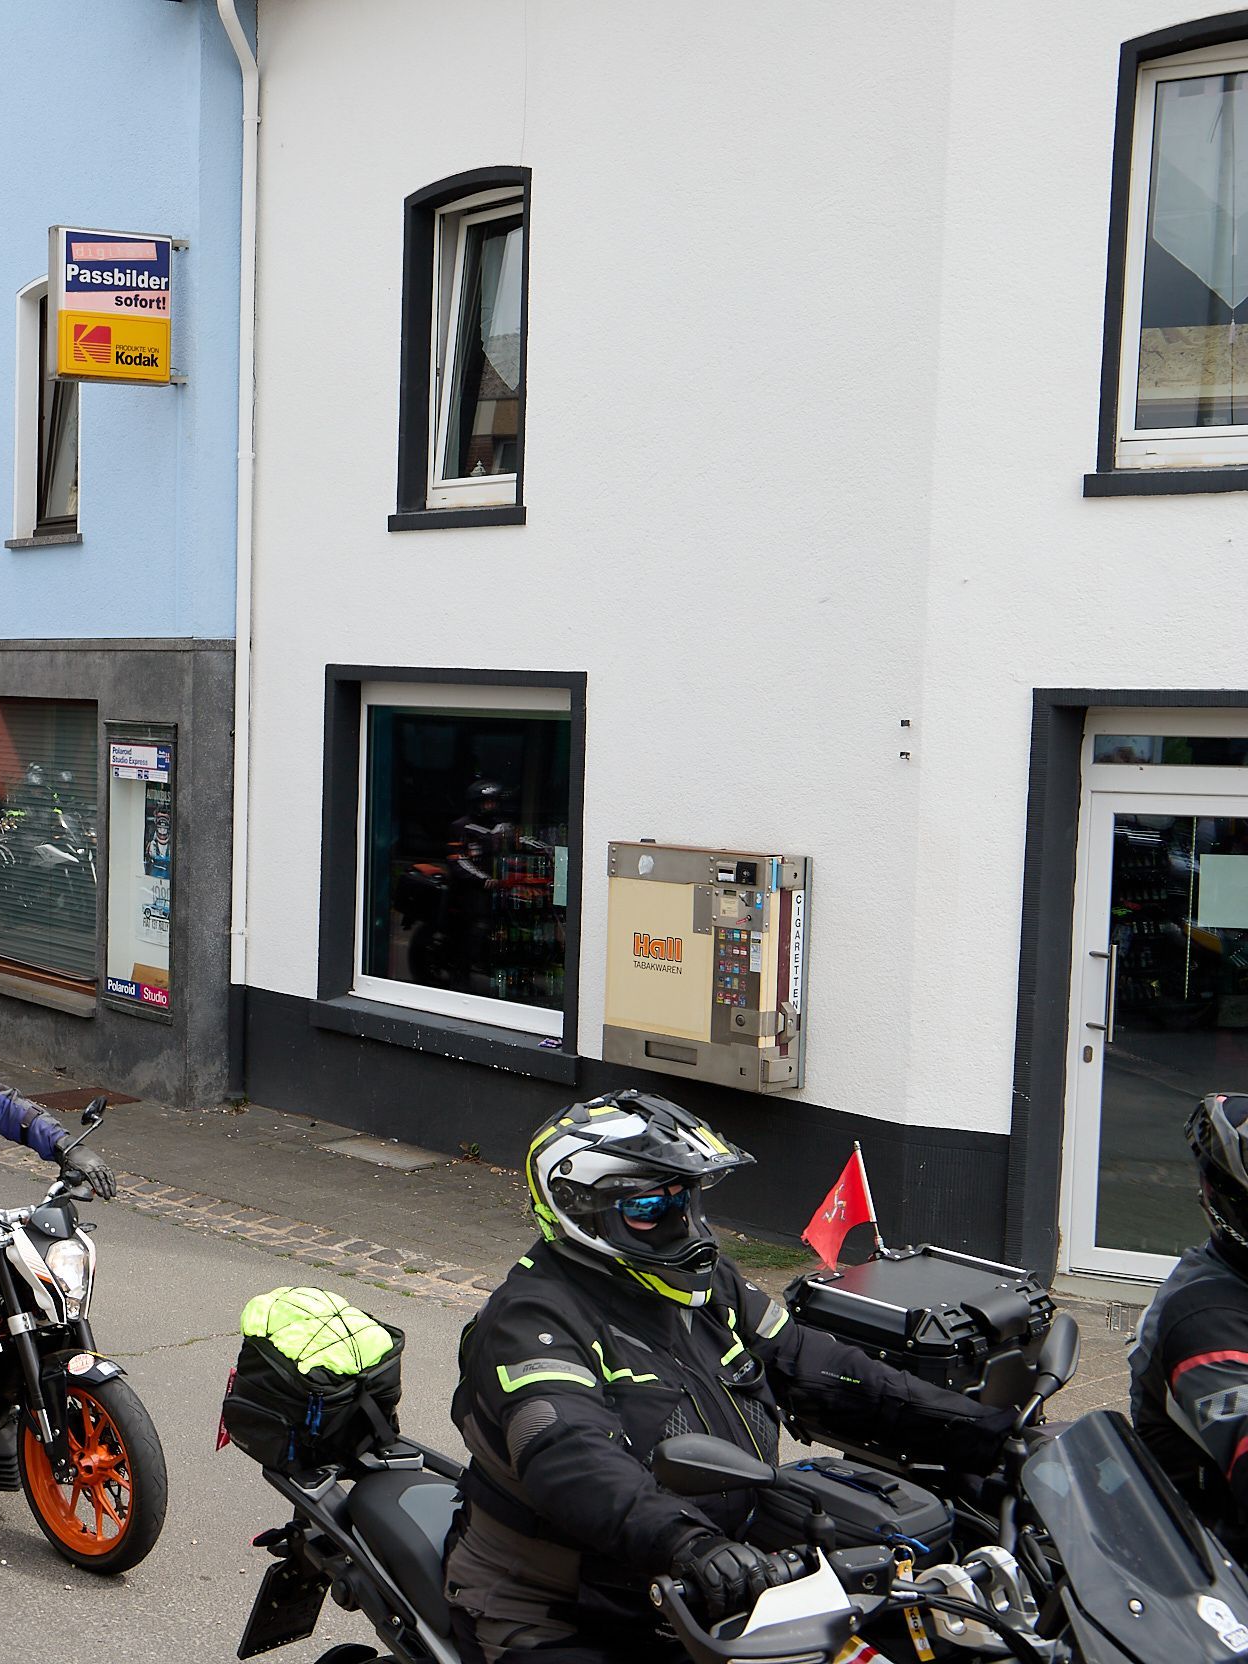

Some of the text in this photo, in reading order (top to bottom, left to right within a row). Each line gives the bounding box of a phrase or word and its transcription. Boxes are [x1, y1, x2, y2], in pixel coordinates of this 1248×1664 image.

[66, 263, 168, 290] Passbilder
[114, 294, 166, 310] sofort!
[115, 344, 160, 354] PRODUKTE VON
[115, 350, 159, 368] Kodak
[112, 746, 132, 756] Polaroid
[112, 755, 129, 764] Studio
[128, 757, 149, 766] Express
[633, 932, 683, 963] Hall
[792, 894, 802, 1010] CIGARETTEN
[633, 960, 683, 975] TABAKWAREN
[107, 979, 168, 1005] Polaroid Studio
